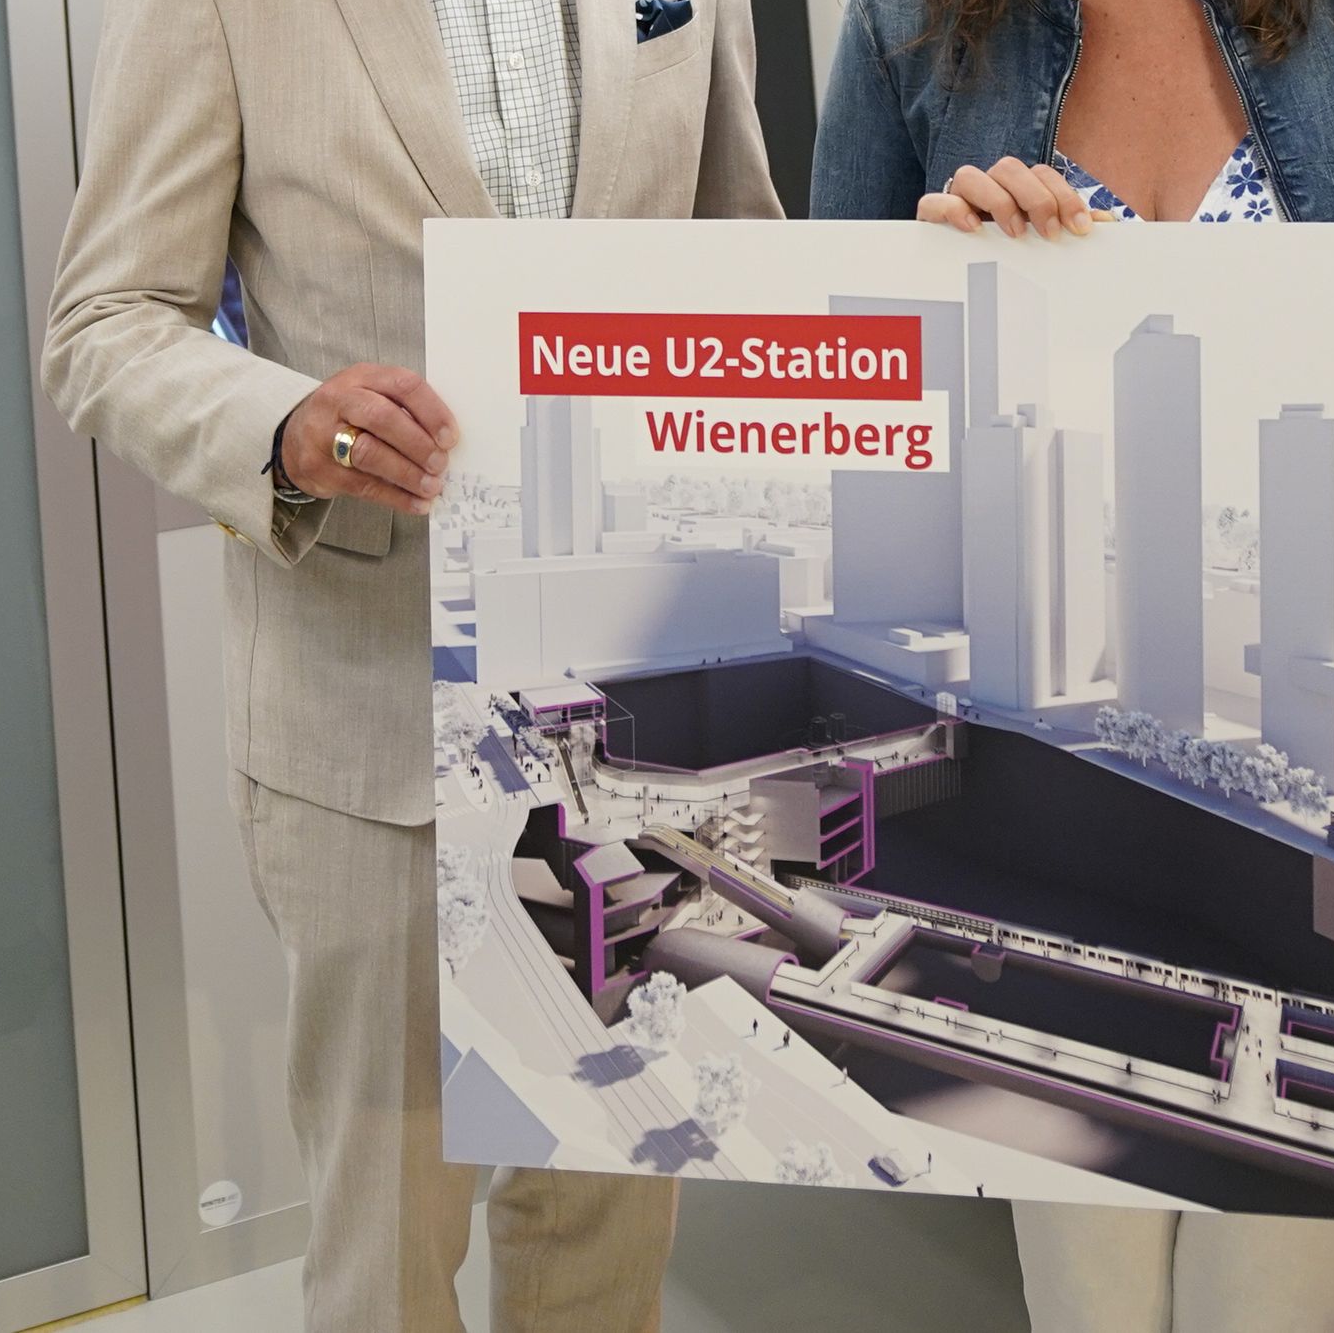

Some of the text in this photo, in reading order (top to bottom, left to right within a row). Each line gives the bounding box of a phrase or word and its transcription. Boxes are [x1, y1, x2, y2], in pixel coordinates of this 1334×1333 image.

[531, 335, 910, 381] Neue U2-Station
[646, 409, 934, 470] Wienerberg
